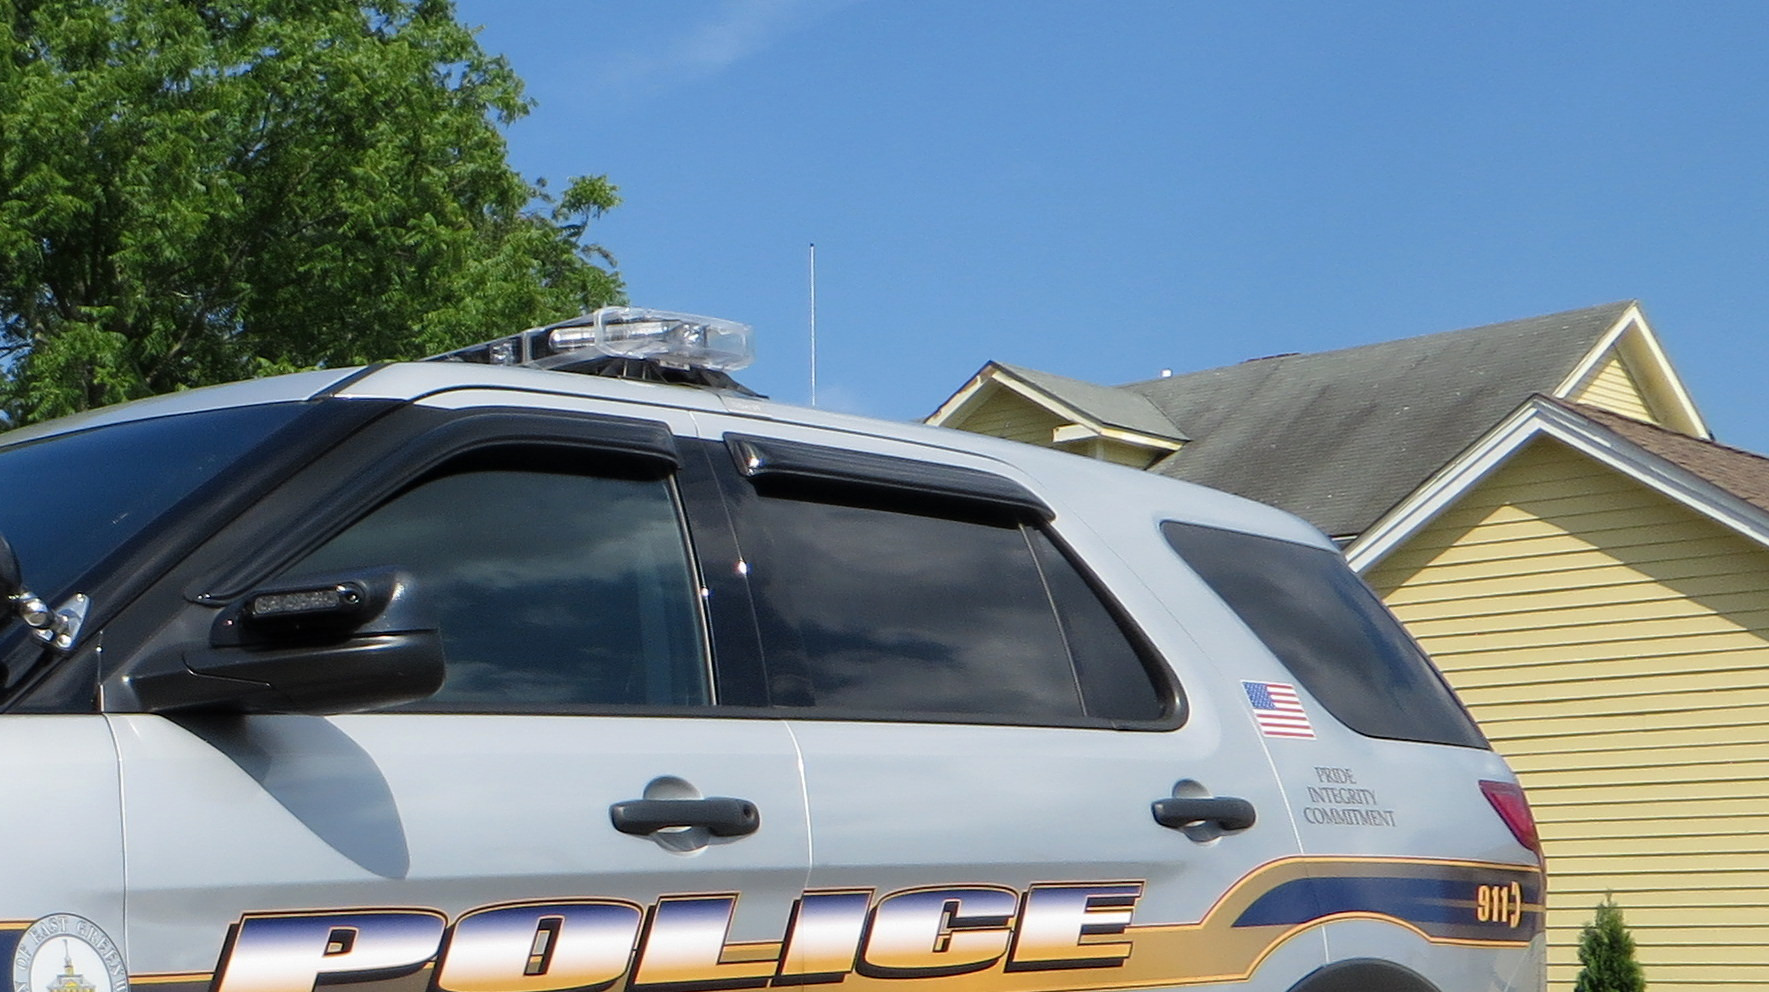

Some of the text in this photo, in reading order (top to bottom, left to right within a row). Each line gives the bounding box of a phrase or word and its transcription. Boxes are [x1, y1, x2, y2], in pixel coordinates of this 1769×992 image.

[1314, 766, 1357, 785] PRIDE
[1306, 786, 1377, 806] INTEGRITY
[1303, 807, 1397, 828] COMMITMENT
[1476, 884, 1509, 923] 911
[15, 943, 33, 972] OF
[28, 915, 70, 946] EAST
